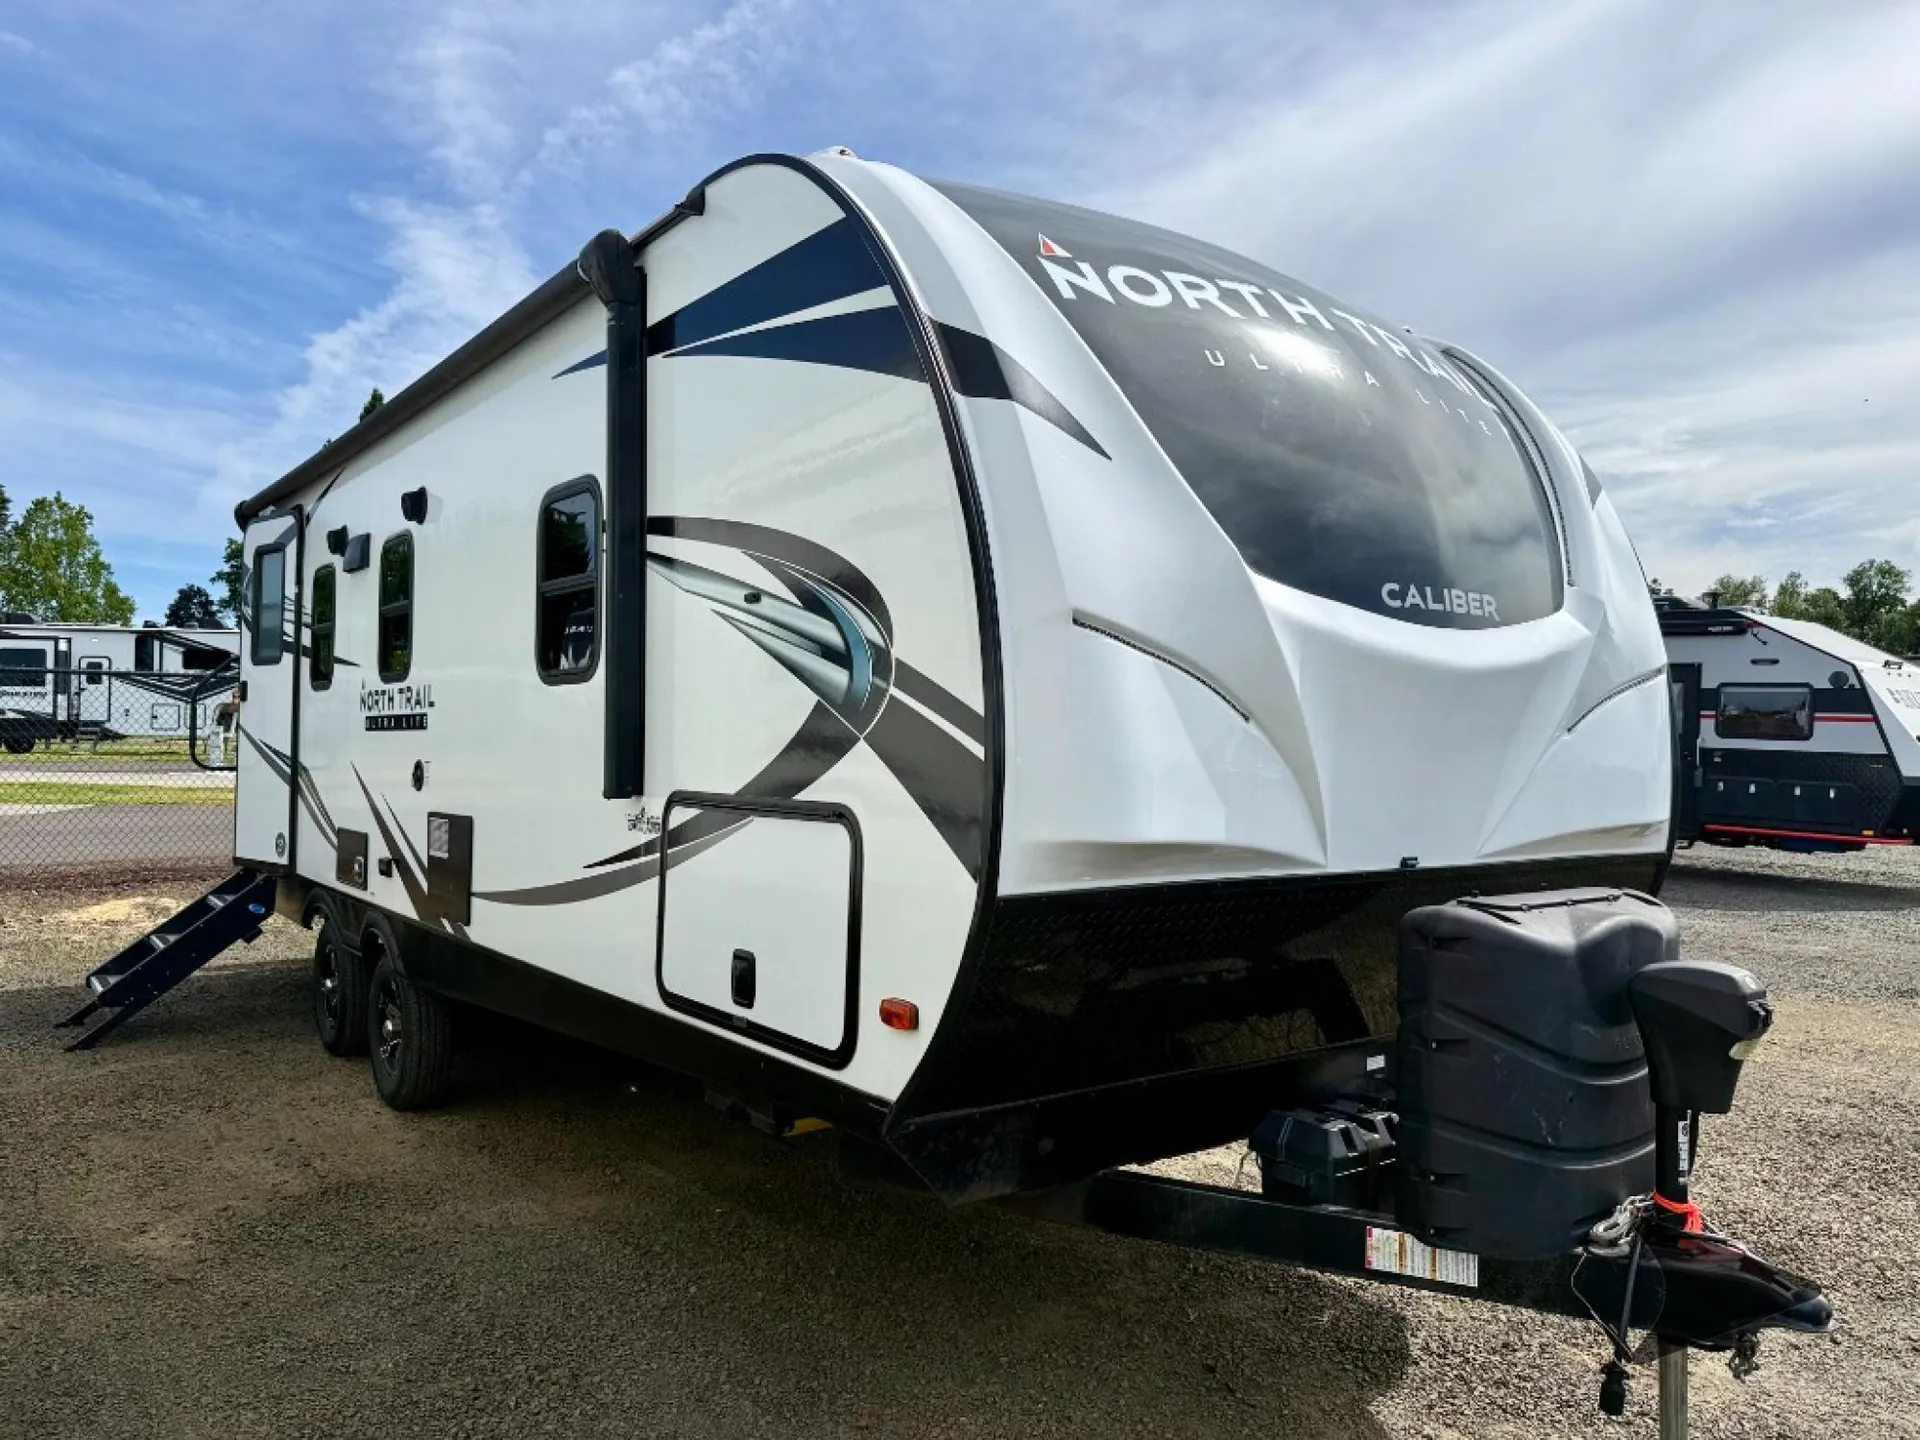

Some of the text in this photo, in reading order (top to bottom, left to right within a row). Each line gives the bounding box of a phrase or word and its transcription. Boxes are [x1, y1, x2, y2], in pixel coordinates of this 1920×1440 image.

[1037, 256, 1499, 413] NORTH TRAIL
[1381, 582, 1500, 621] CALIBER
[360, 684, 436, 713] NORTH TRAIL
